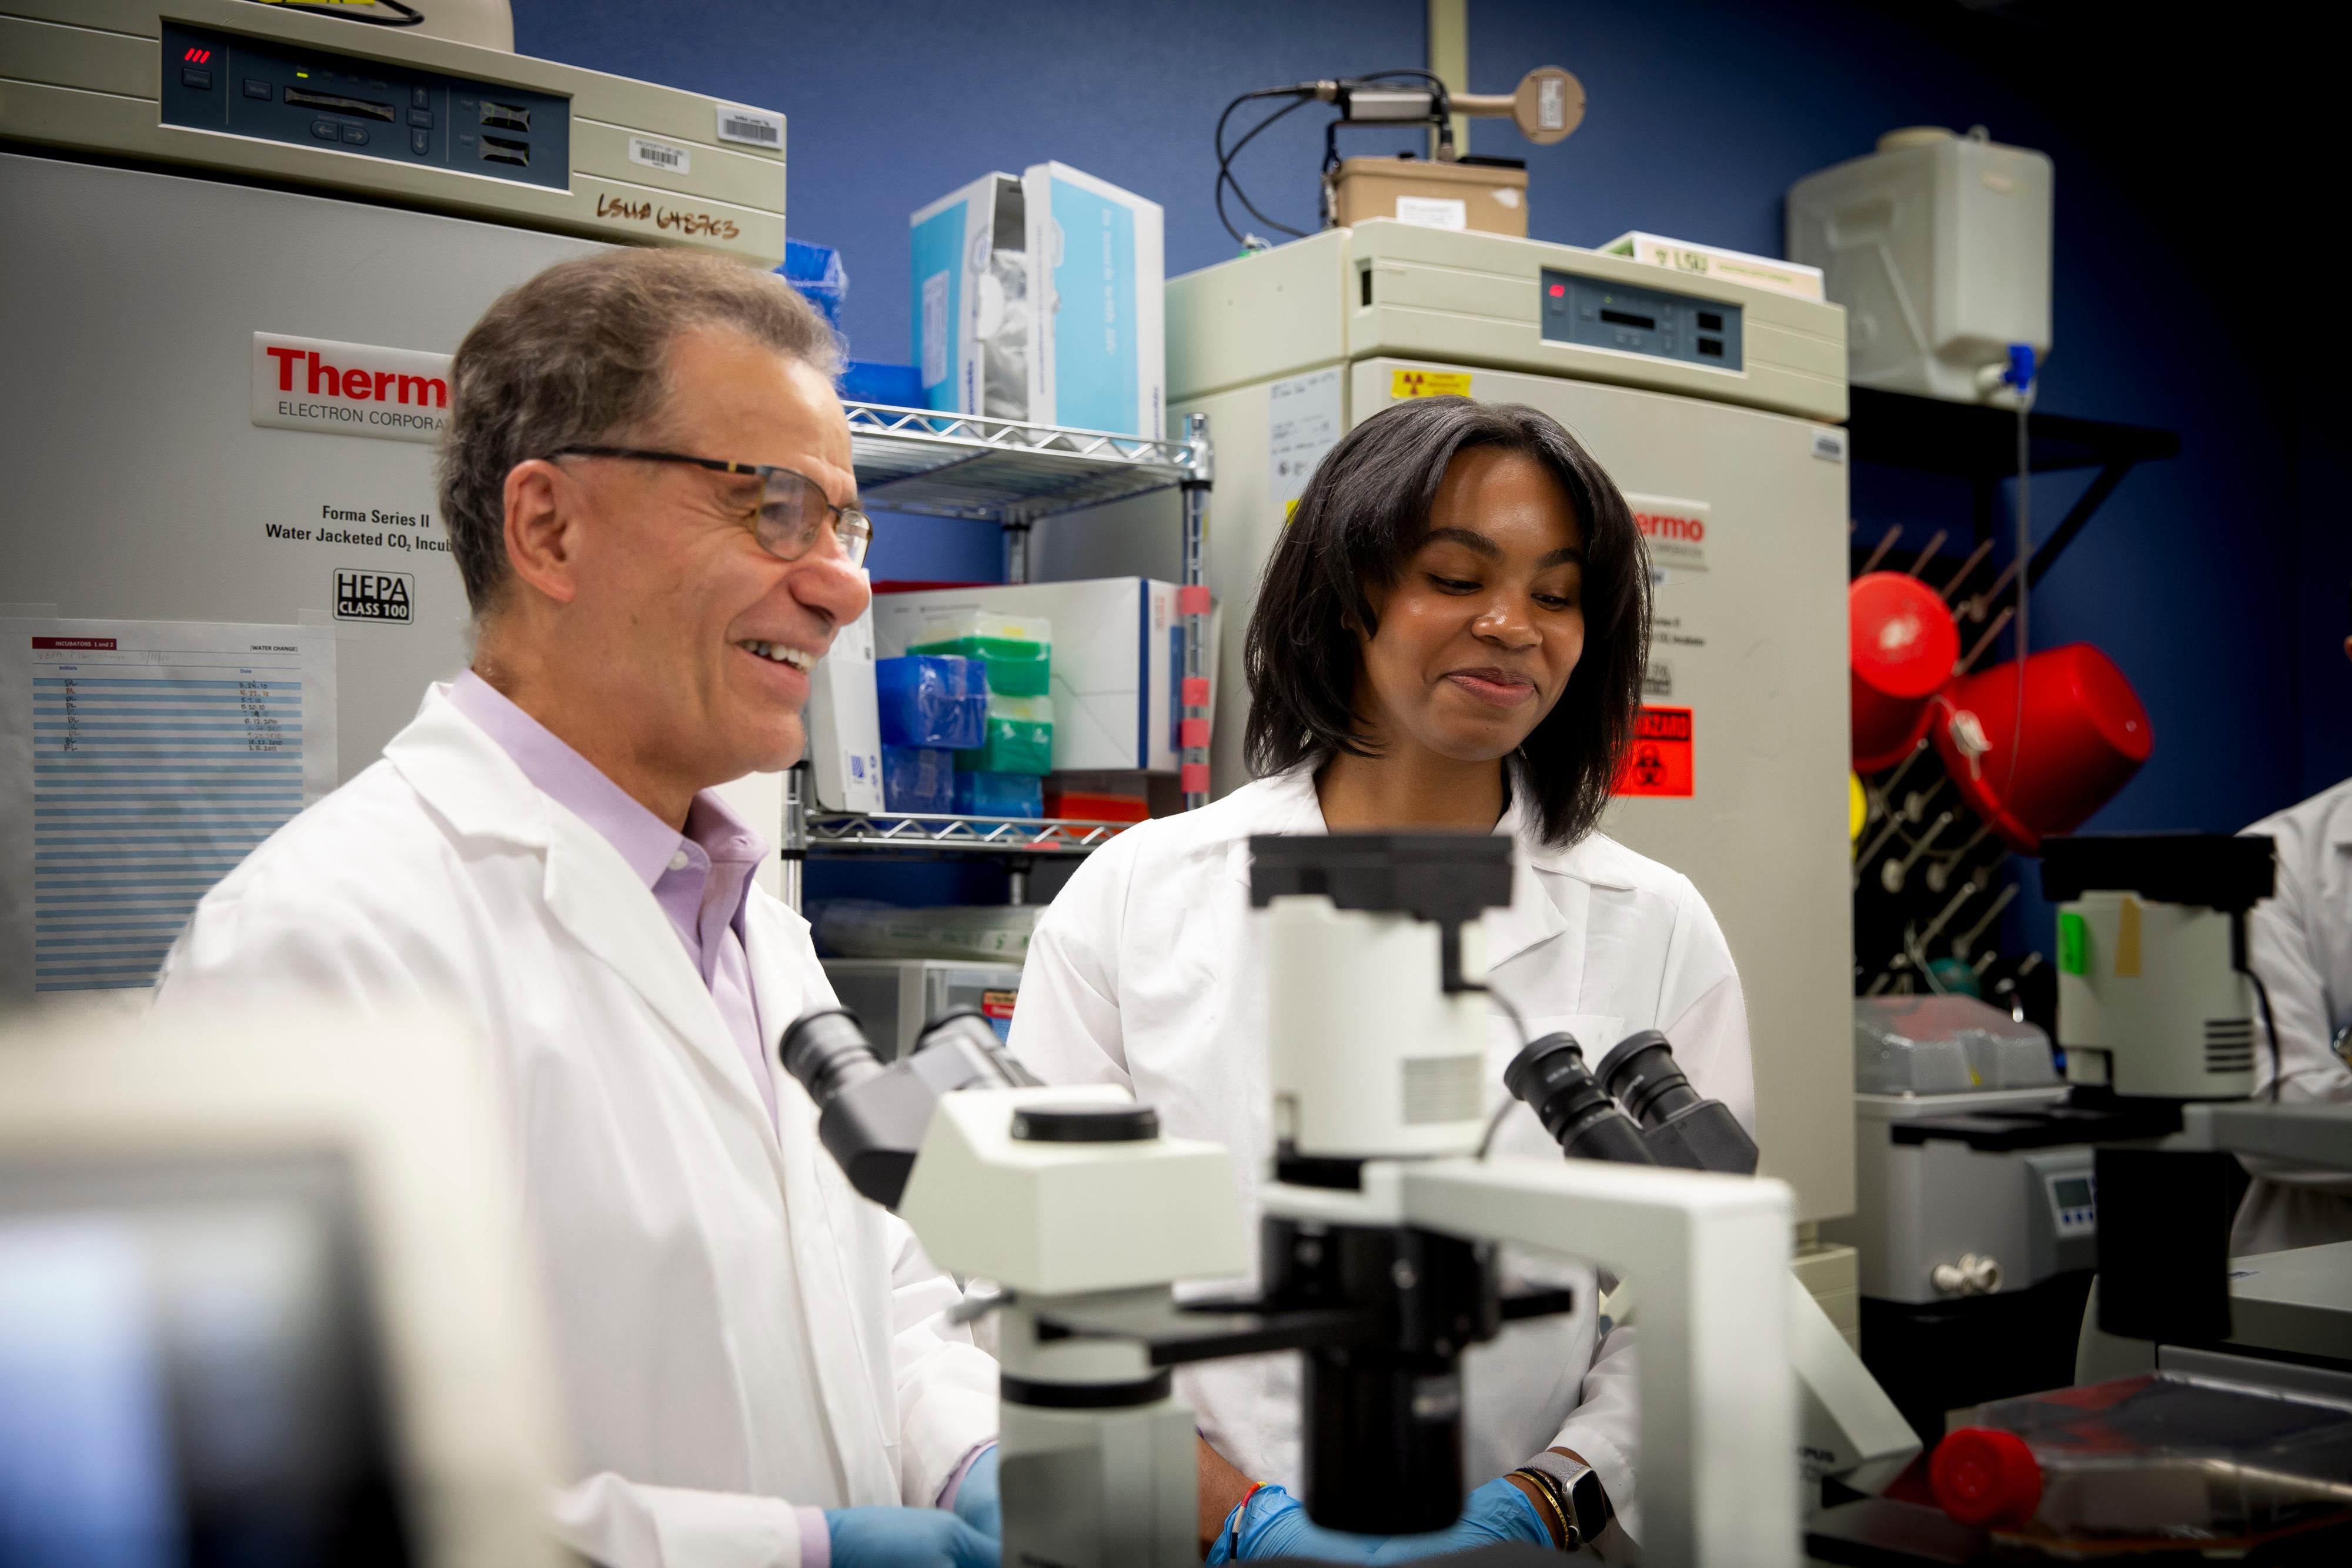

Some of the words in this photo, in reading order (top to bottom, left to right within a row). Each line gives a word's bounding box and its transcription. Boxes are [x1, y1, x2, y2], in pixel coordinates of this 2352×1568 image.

[249, 85, 266, 95] Mode
[267, 347, 449, 409] Therm
[278, 401, 363, 423] ELECTRON
[369, 410, 449, 430] CORPORA
[323, 505, 366, 523] Forma
[371, 509, 416, 527] Series
[420, 514, 430, 528] II
[1636, 512, 1705, 542] ermo
[265, 523, 311, 540] Water
[315, 527, 383, 546] Jacketed
[415, 536, 452, 552] Incub
[338, 573, 409, 602] HEPA
[339, 600, 380, 617] CLASS
[383, 603, 408, 618] 100
